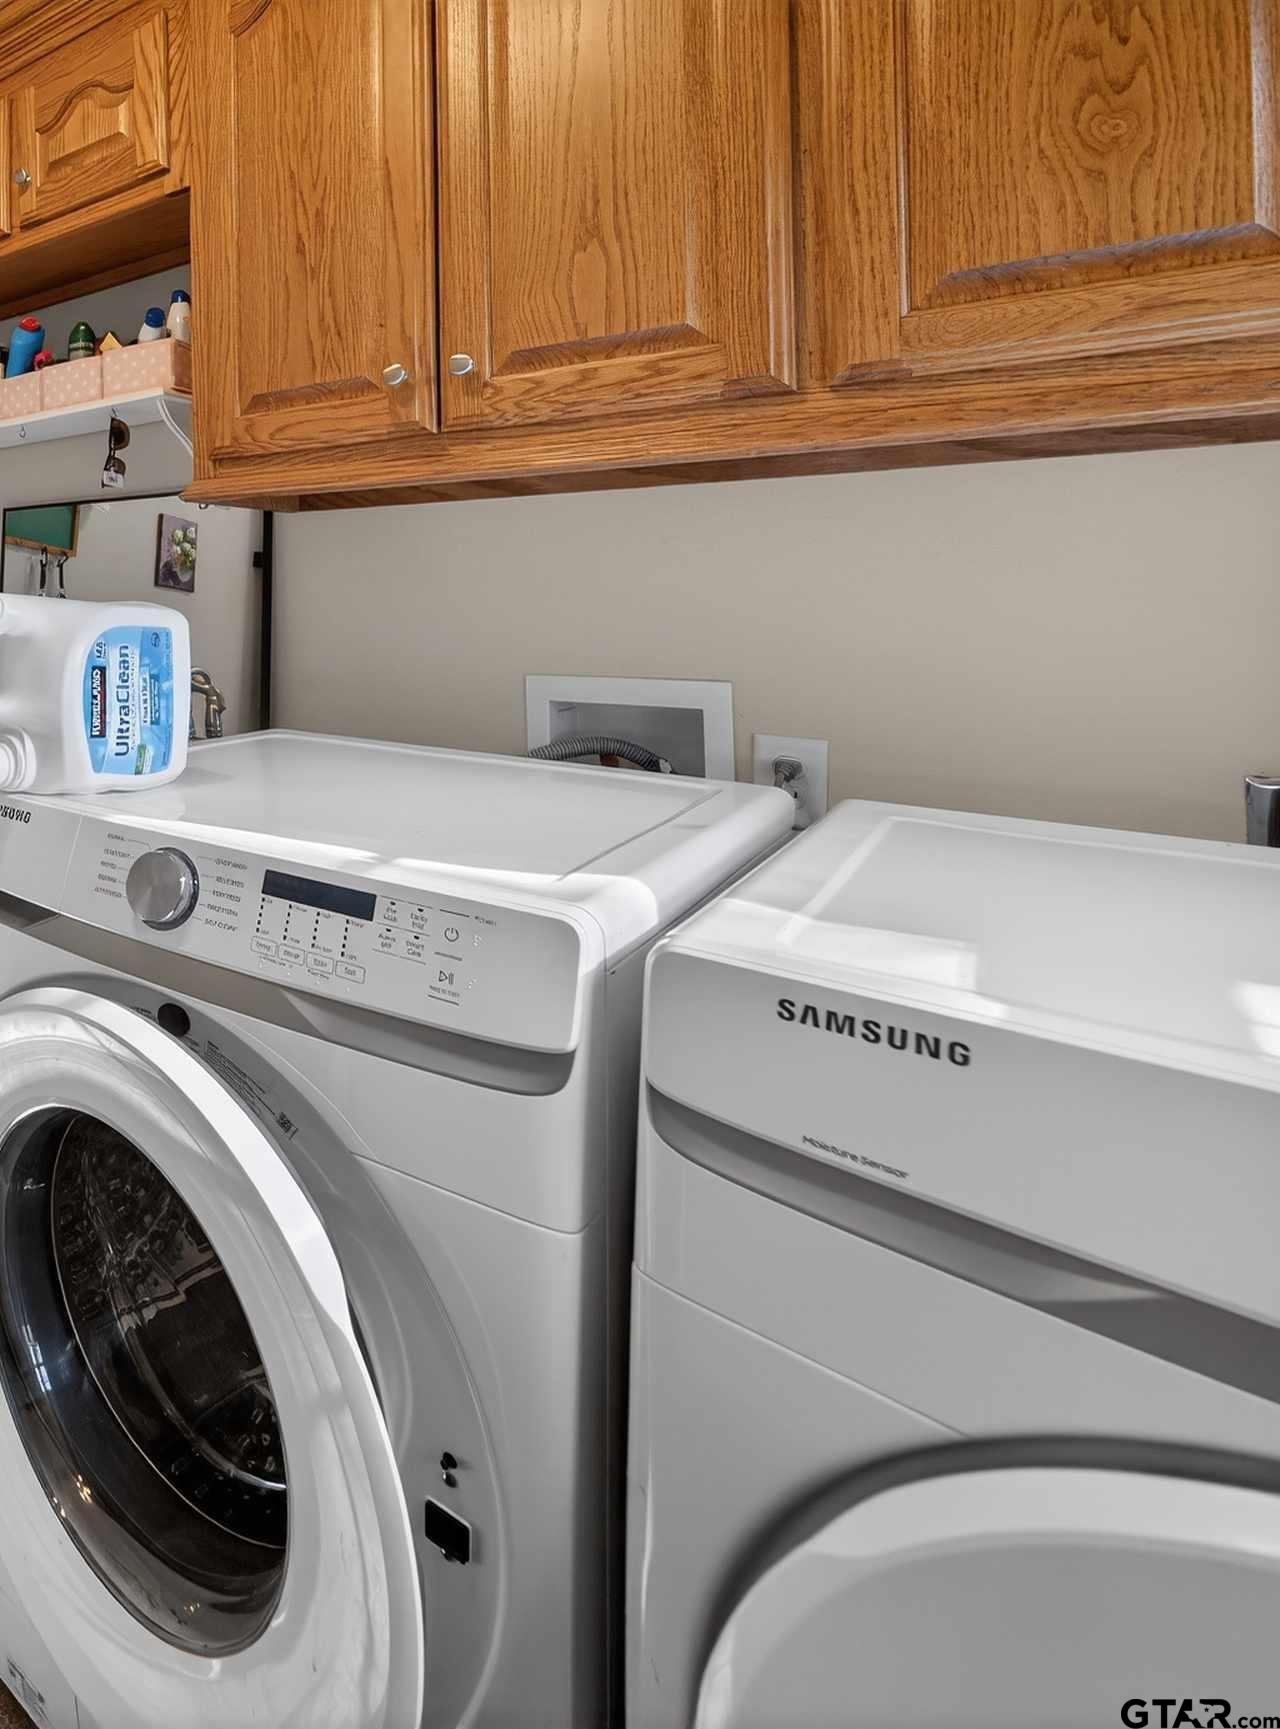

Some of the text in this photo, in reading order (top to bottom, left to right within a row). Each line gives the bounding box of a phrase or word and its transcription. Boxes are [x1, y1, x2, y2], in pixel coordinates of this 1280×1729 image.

[114, 644, 130, 757] UltraClean
[776, 998, 972, 1067] SAMSUNG
[802, 1134, 909, 1179] Moisture Sensor
